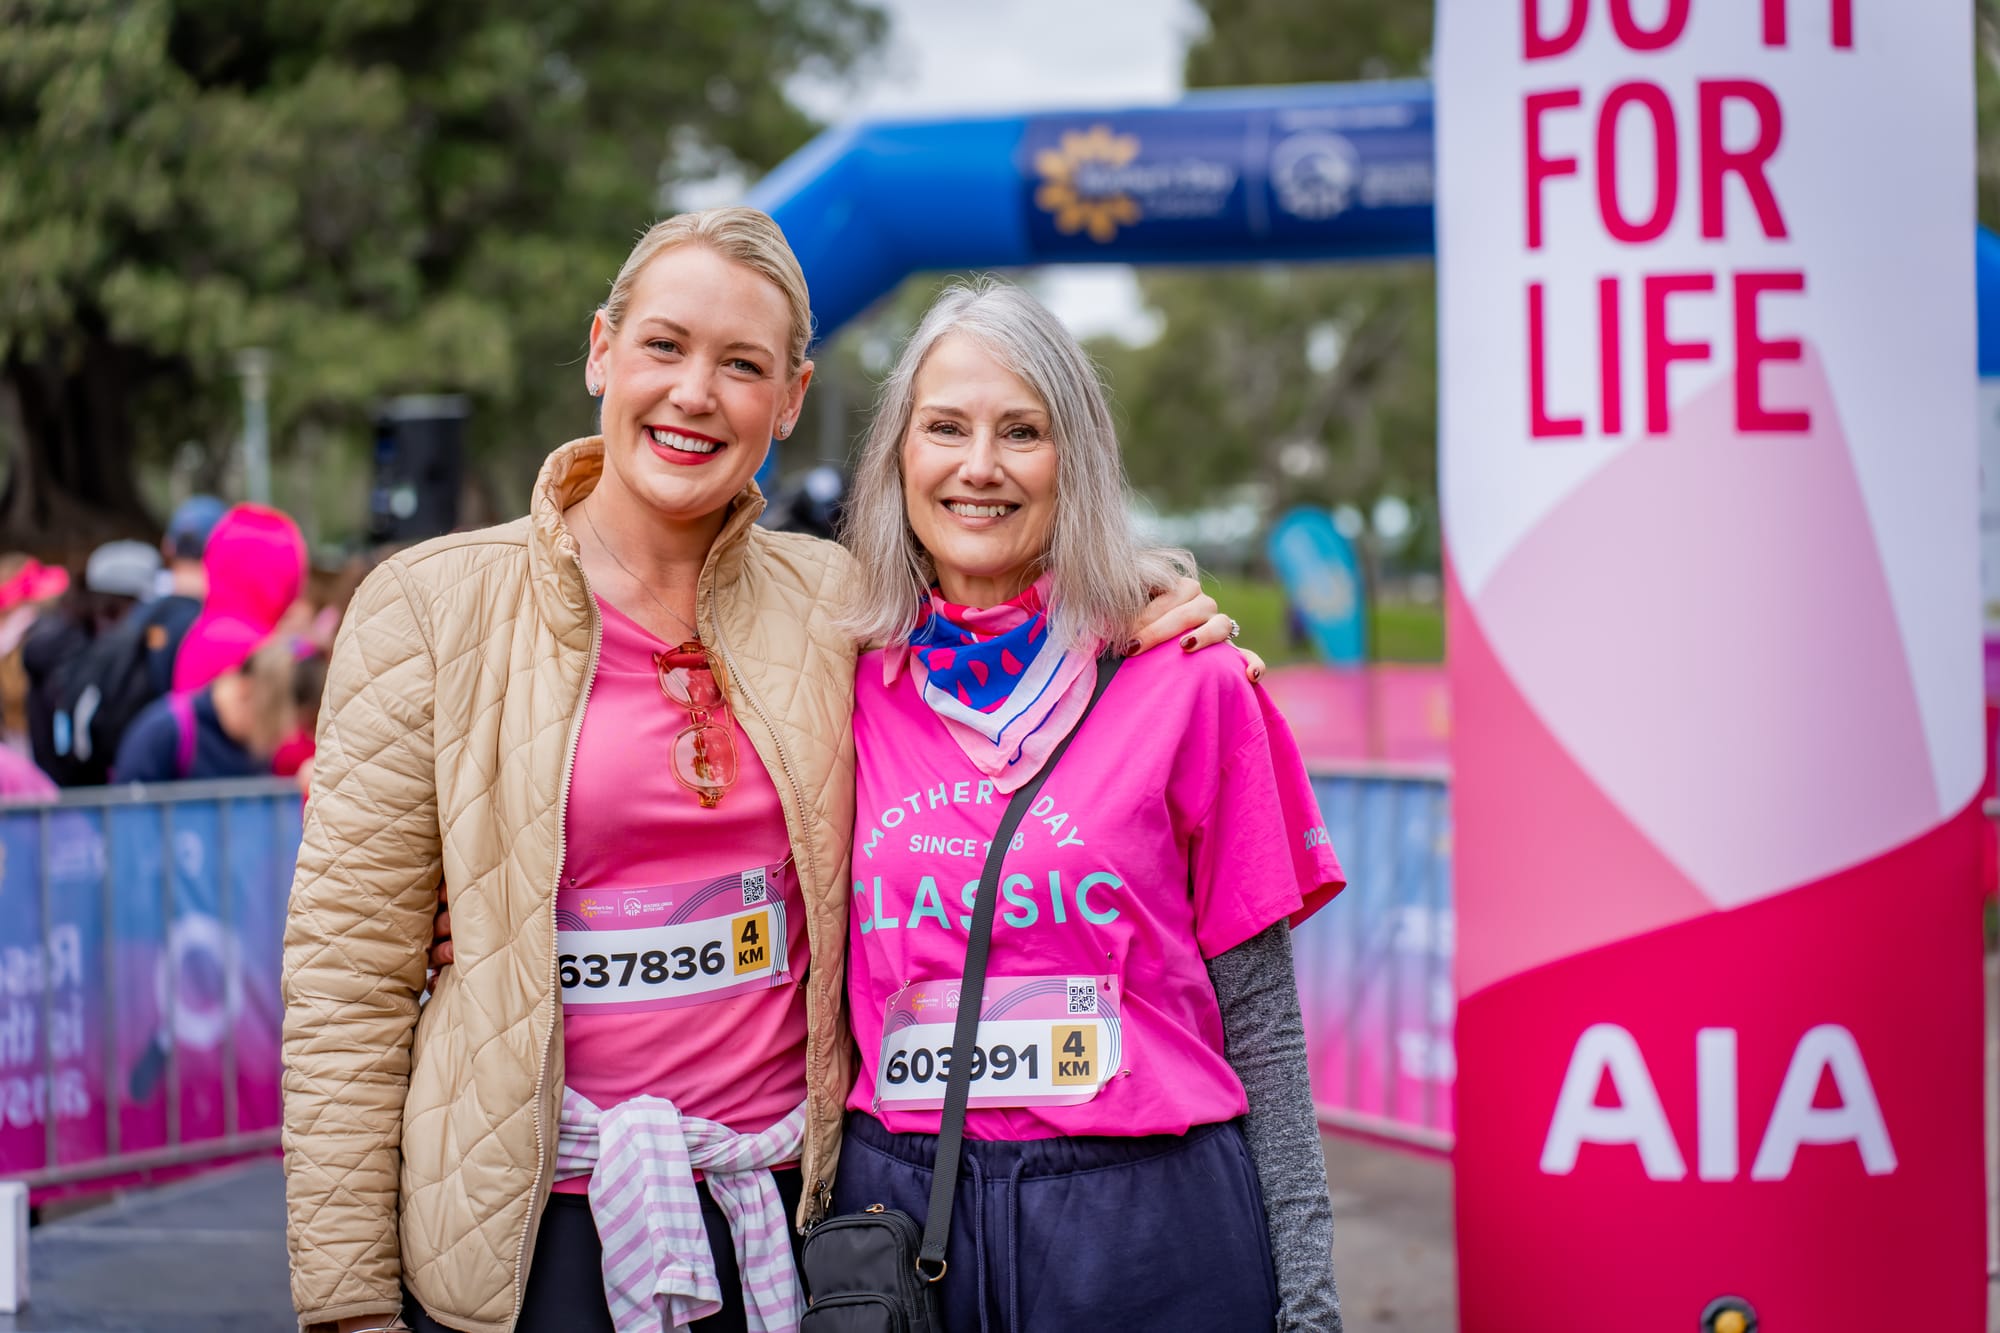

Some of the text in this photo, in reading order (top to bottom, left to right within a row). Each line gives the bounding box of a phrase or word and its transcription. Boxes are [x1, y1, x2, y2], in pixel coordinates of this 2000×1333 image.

[1523, 78, 1790, 250] FOR
[1527, 272, 1811, 438] LIFE
[863, 780, 1085, 859] MOTHER DAY
[908, 832, 1025, 859] SINCE 18
[741, 919, 760, 946] 4
[558, 940, 726, 989] 637836
[738, 946, 764, 967] KM
[1062, 1030, 1086, 1058] 4
[1058, 1060, 1090, 1077] KM
[1538, 1022, 1899, 1182] AIA
